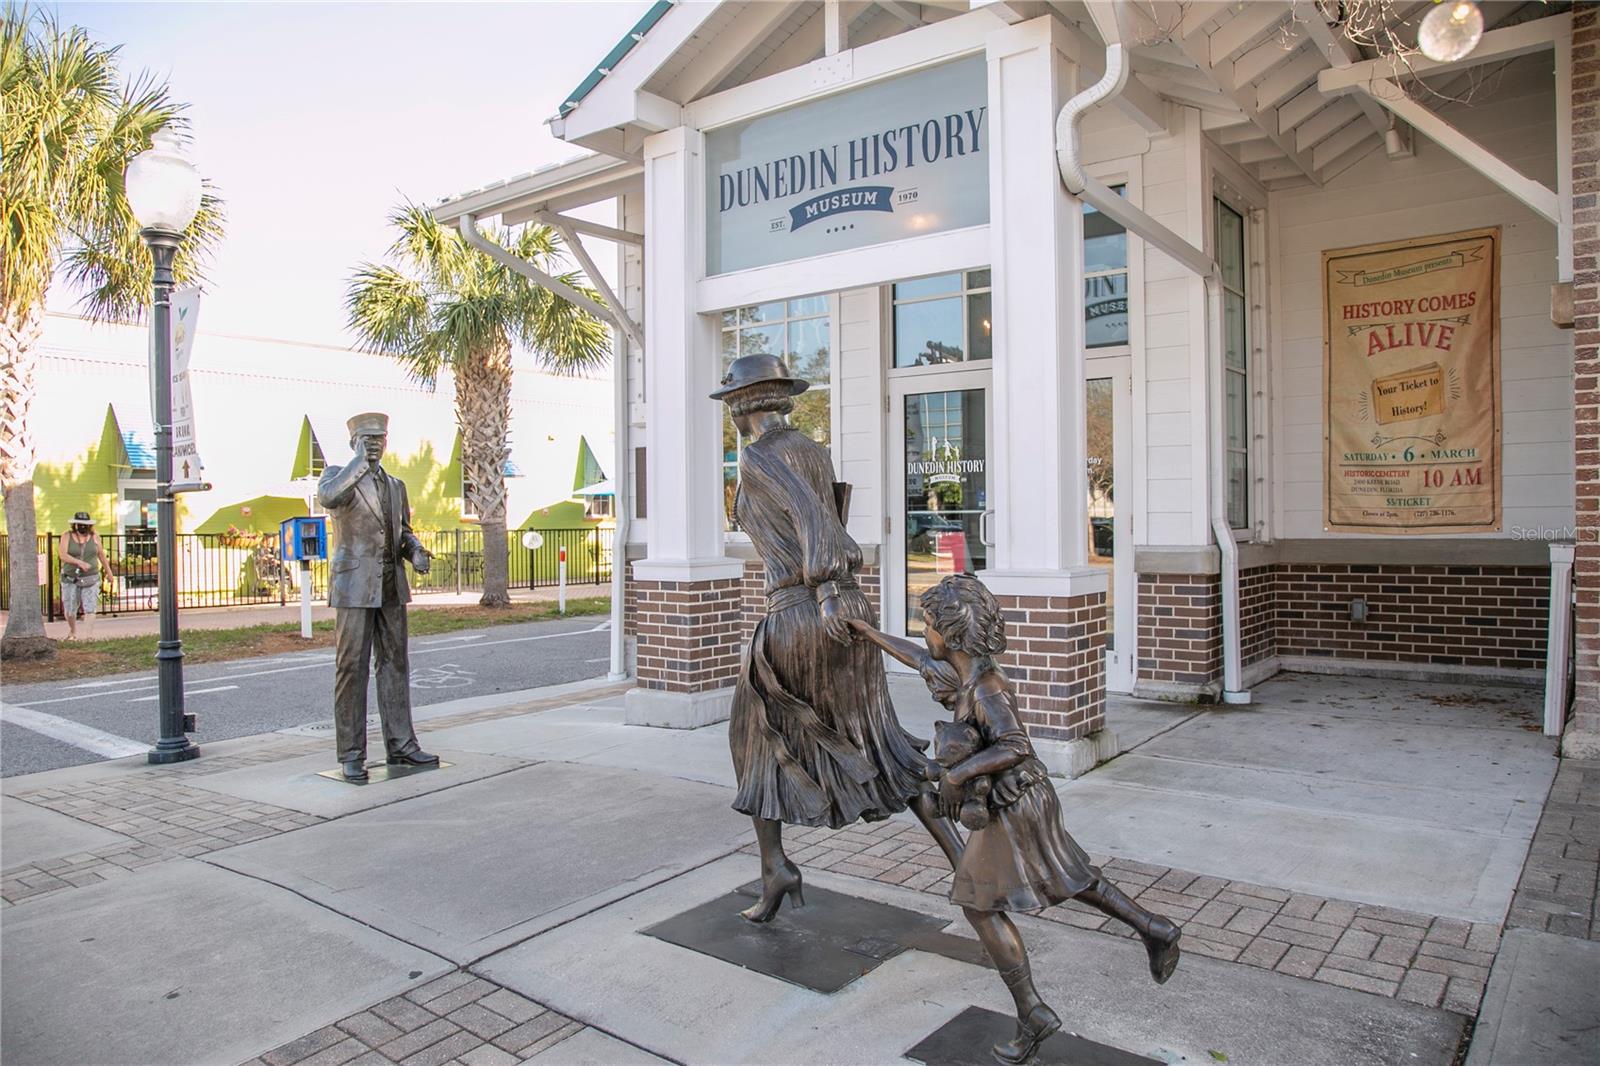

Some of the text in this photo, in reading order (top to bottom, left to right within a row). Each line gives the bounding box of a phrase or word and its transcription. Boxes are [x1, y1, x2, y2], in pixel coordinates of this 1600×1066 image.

[719, 106, 987, 213] DUNEDIN HISTORY
[804, 191, 879, 219] MUSEUM
[898, 191, 918, 202] 1970
[770, 220, 786, 230] EST.
[1342, 291, 1477, 320] HISTORY COMES
[1367, 321, 1457, 357] ALIVE
[1377, 378, 1439, 396] Your Ticket to
[1391, 401, 1428, 416] History!
[1344, 445, 1475, 462] SATURDAY 6 MARCH
[907, 459, 985, 474] DUNEDIN HISTORY
[1423, 467, 1482, 488] 10 AM
